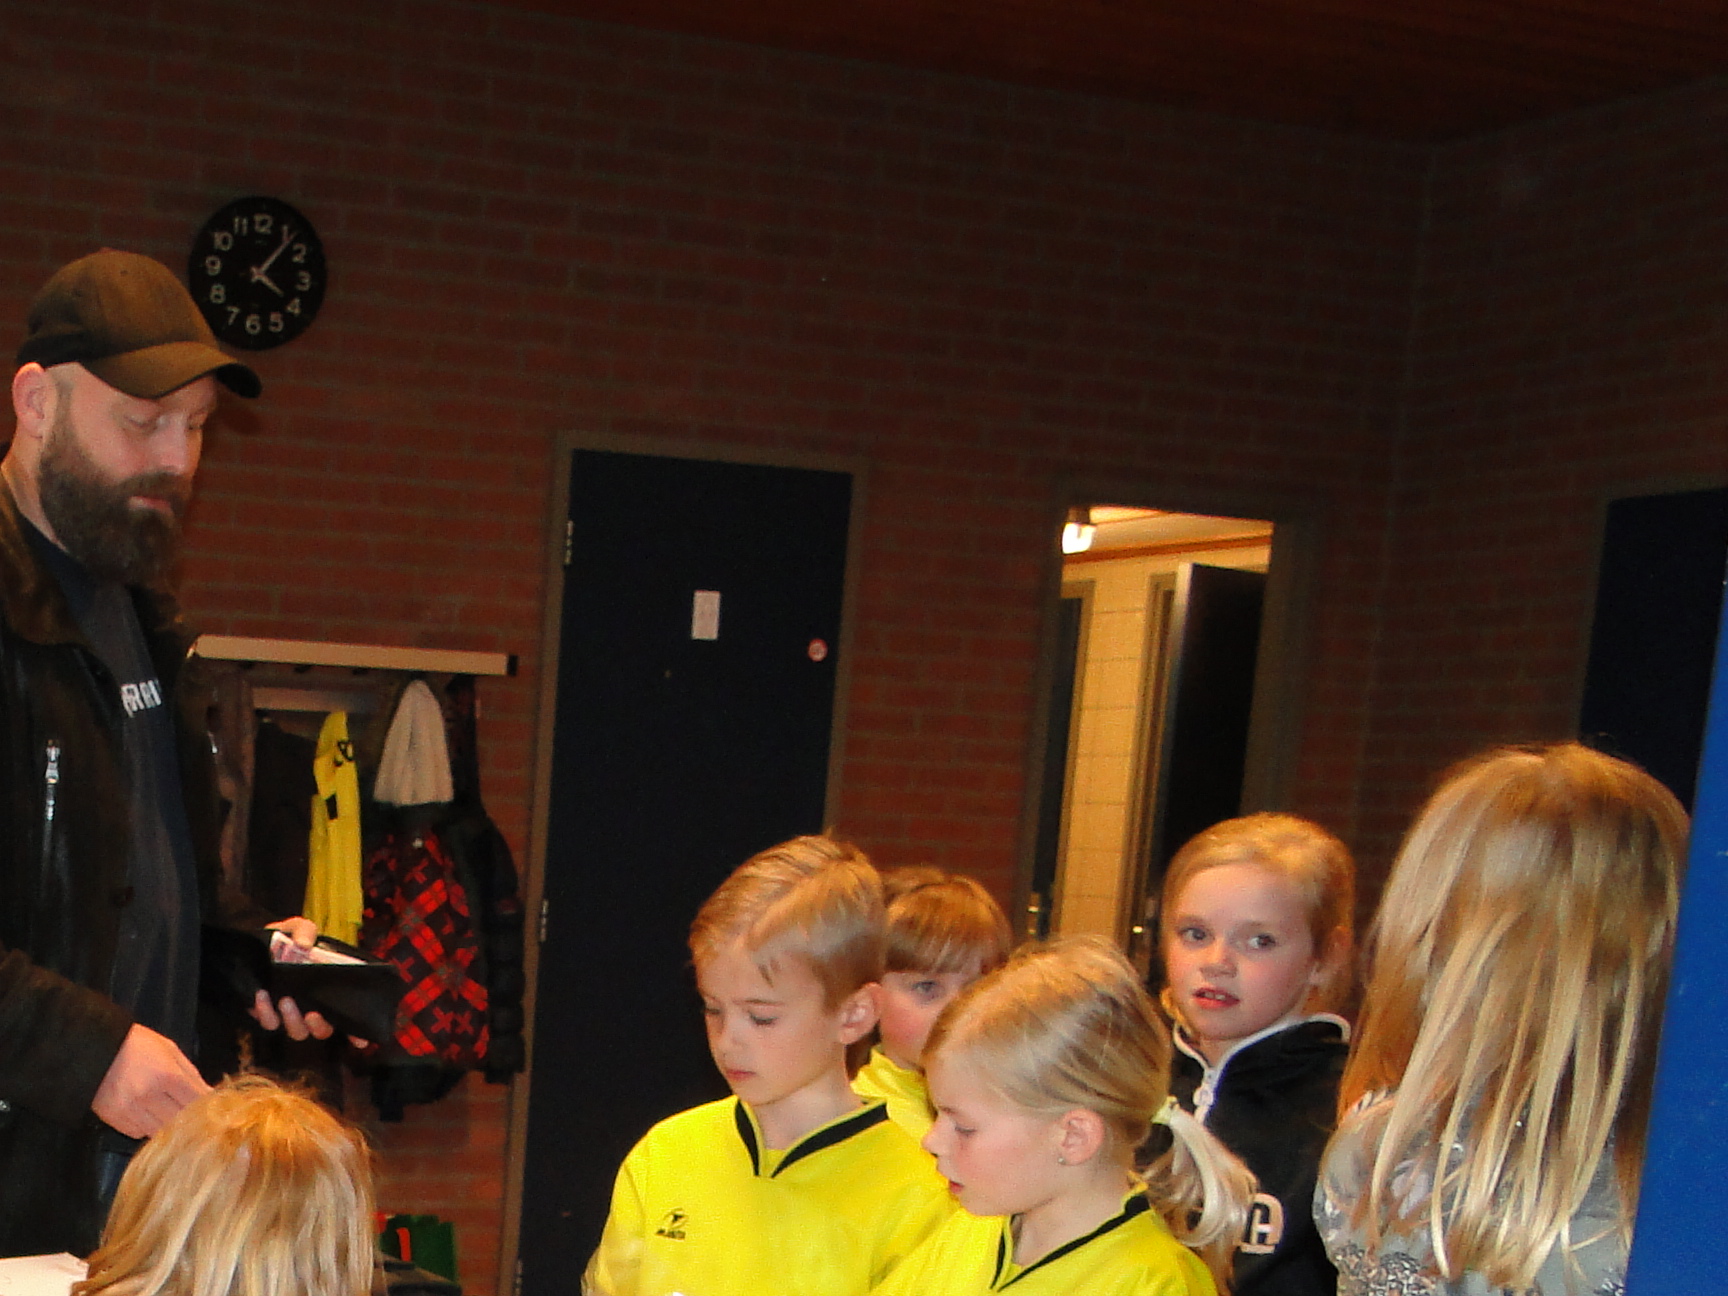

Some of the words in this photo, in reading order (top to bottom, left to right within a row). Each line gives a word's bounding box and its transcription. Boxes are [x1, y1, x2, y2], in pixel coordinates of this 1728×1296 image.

[234, 216, 248, 236] 11
[253, 213, 273, 235] 12
[214, 231, 233, 251] 10
[292, 243, 307, 263] 2
[205, 255, 221, 276] 9
[296, 270, 312, 291] 3
[209, 283, 226, 304] 8
[226, 305, 240, 326] 7
[286, 297, 301, 317] 4
[245, 313, 261, 335] 6
[269, 311, 284, 333] 5
